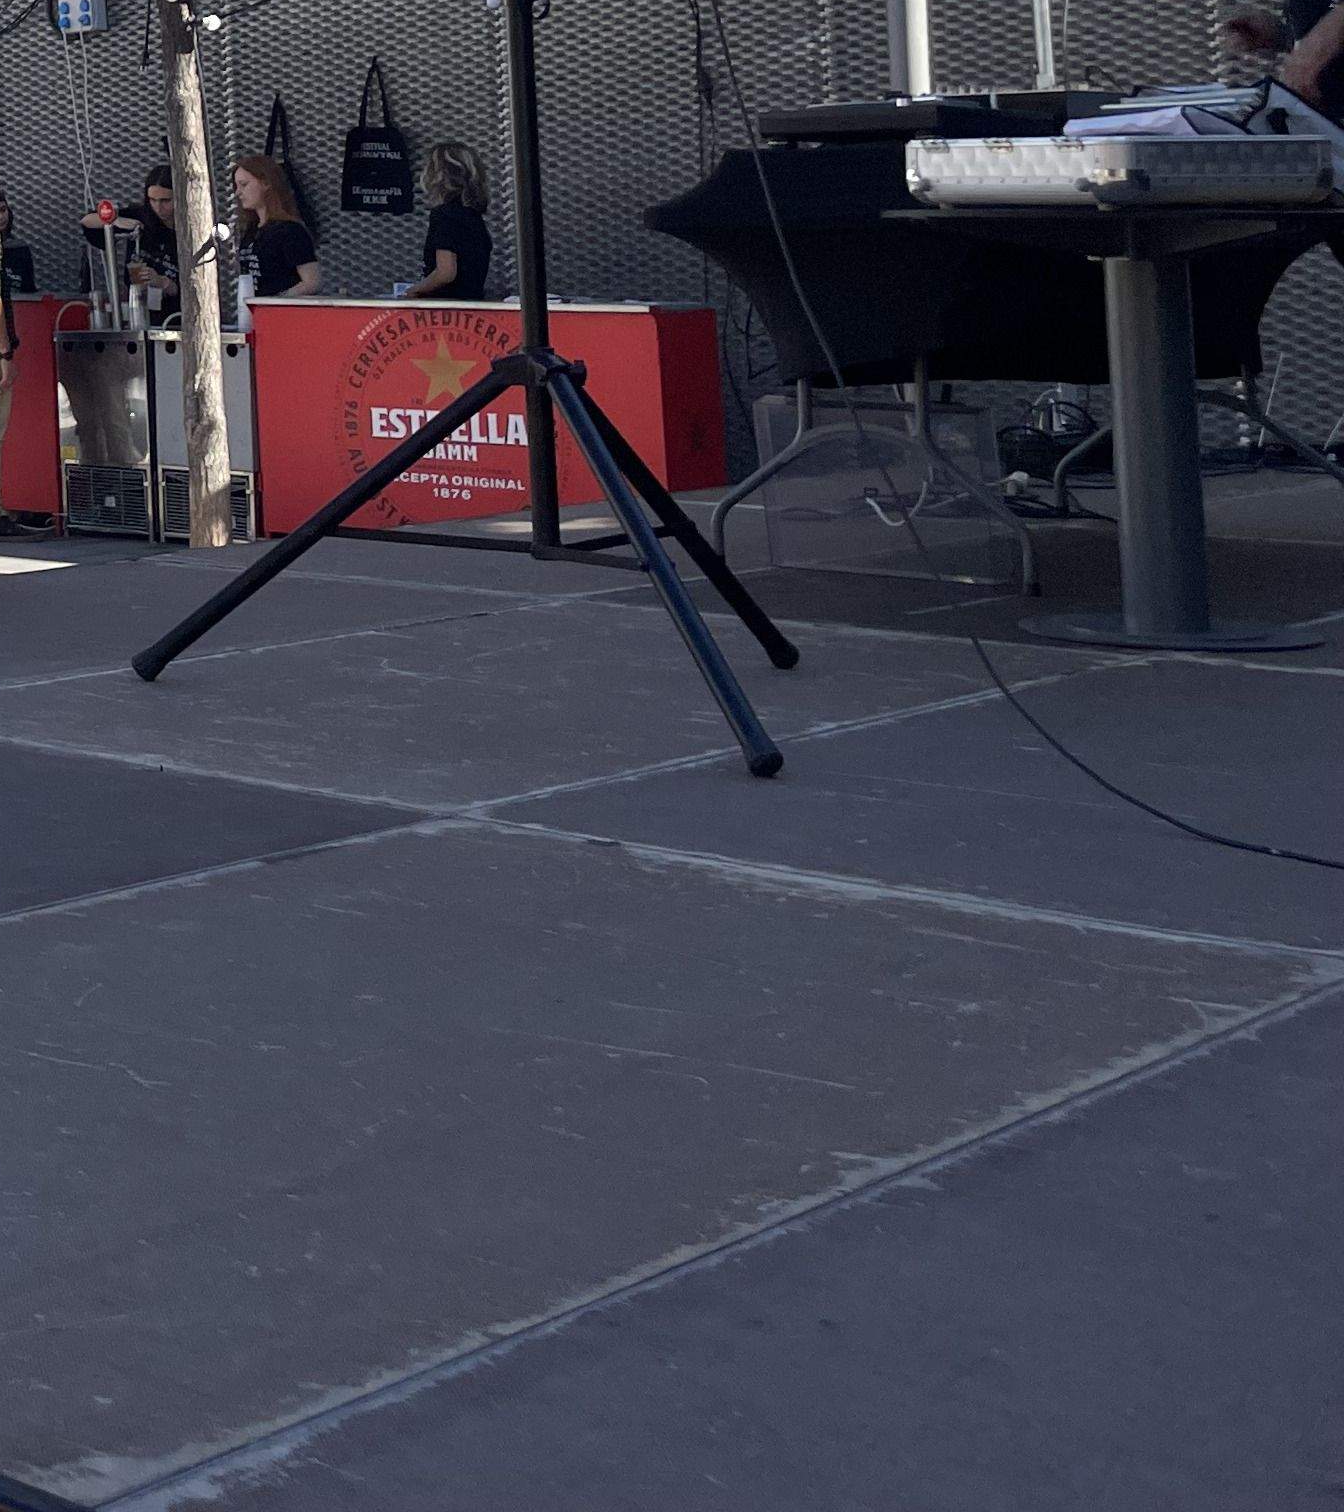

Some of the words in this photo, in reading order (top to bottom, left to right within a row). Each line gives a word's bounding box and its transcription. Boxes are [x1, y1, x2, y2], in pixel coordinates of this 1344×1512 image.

[349, 317, 411, 389] CERVESA
[393, 472, 449, 485] CEPTA
[451, 475, 526, 491] ORIGINAL
[432, 487, 472, 501] 1876
